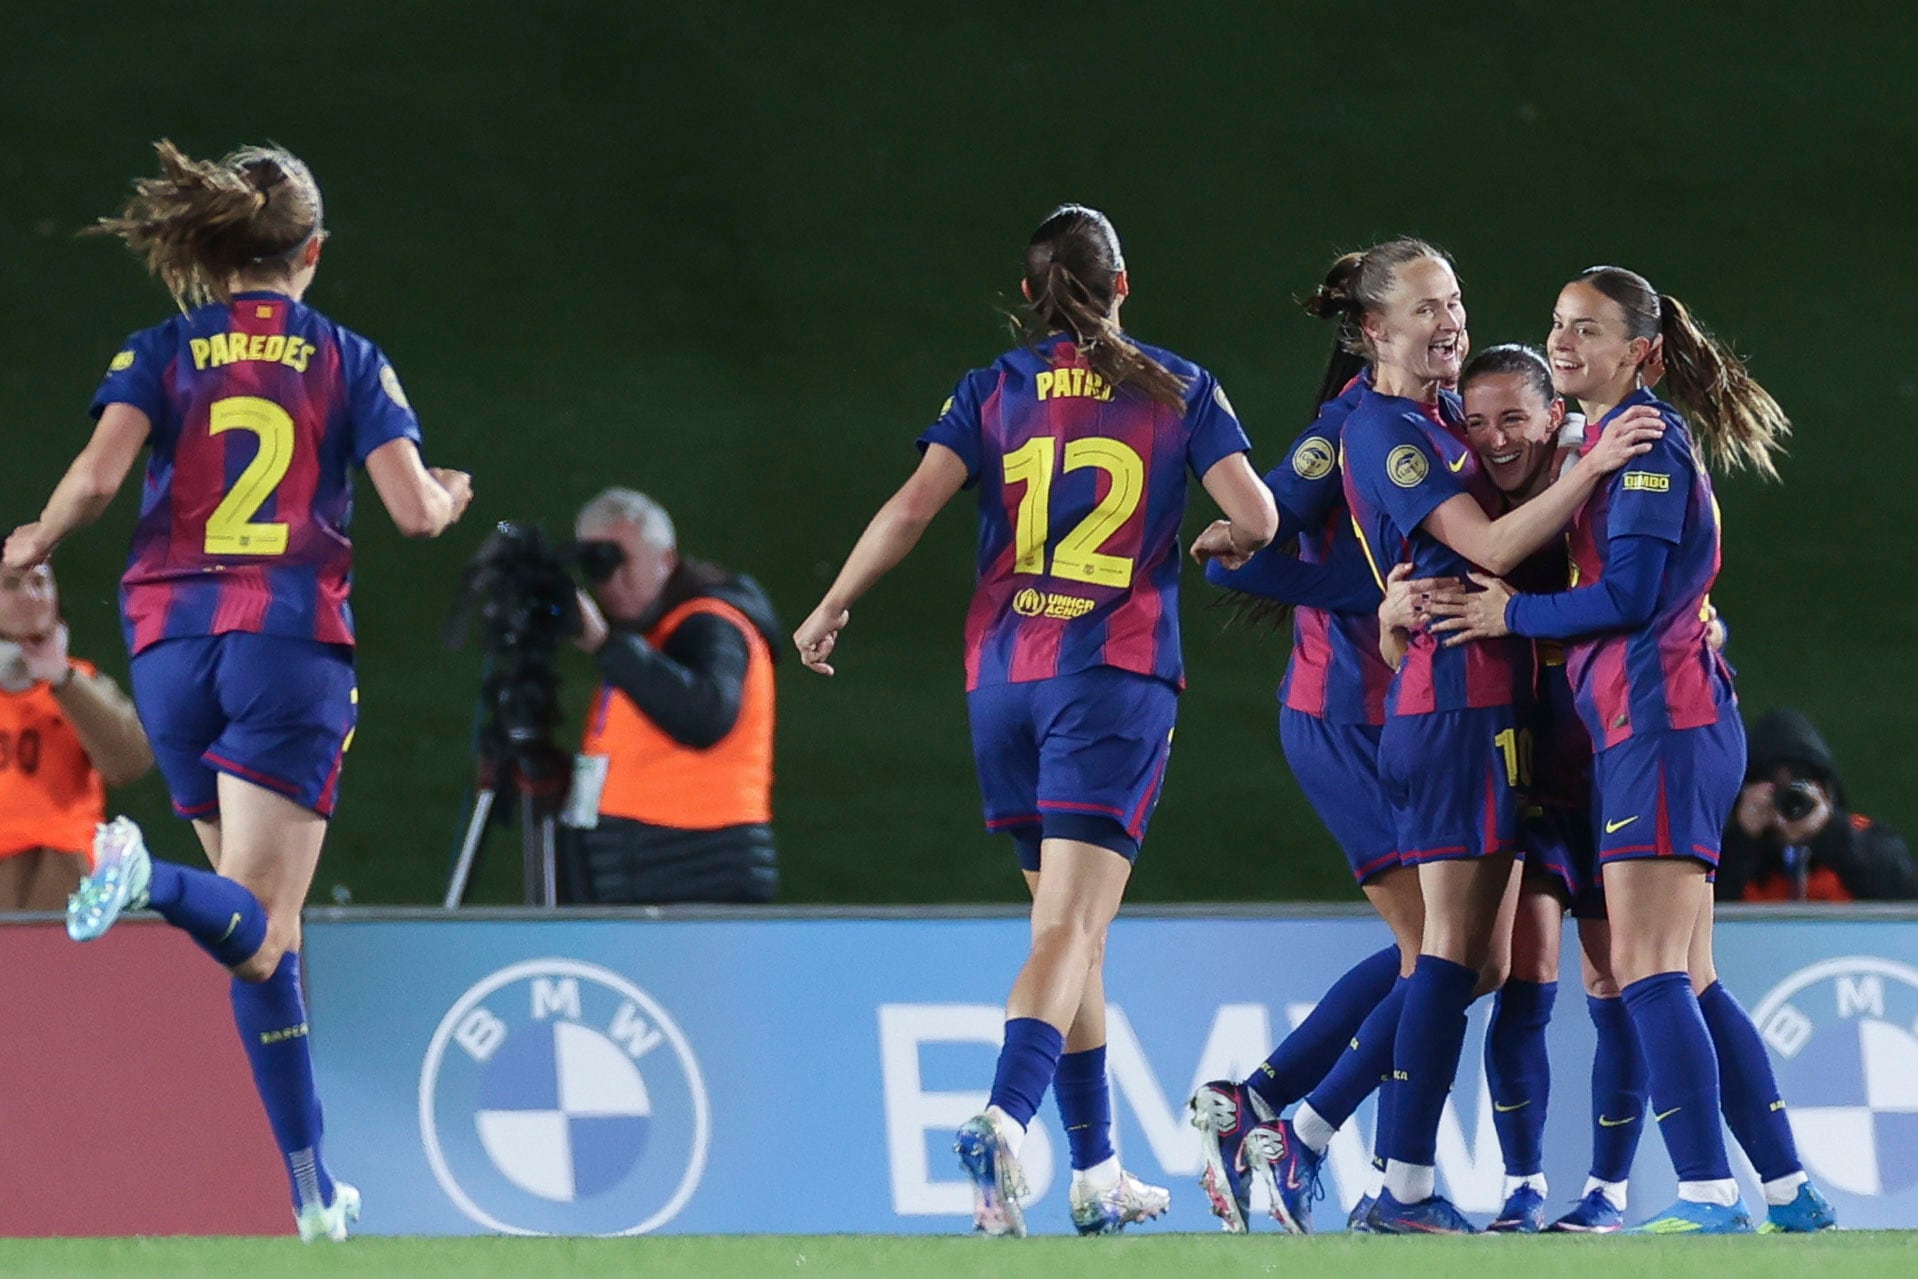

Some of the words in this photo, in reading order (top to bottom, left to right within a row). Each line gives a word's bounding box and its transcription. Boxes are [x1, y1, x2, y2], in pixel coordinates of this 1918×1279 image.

[189, 331, 317, 373] PAREDES
[204, 395, 296, 556] 2
[1002, 436, 1144, 589] 12
[453, 976, 663, 1061] BMW
[1762, 974, 1918, 1060] BM
